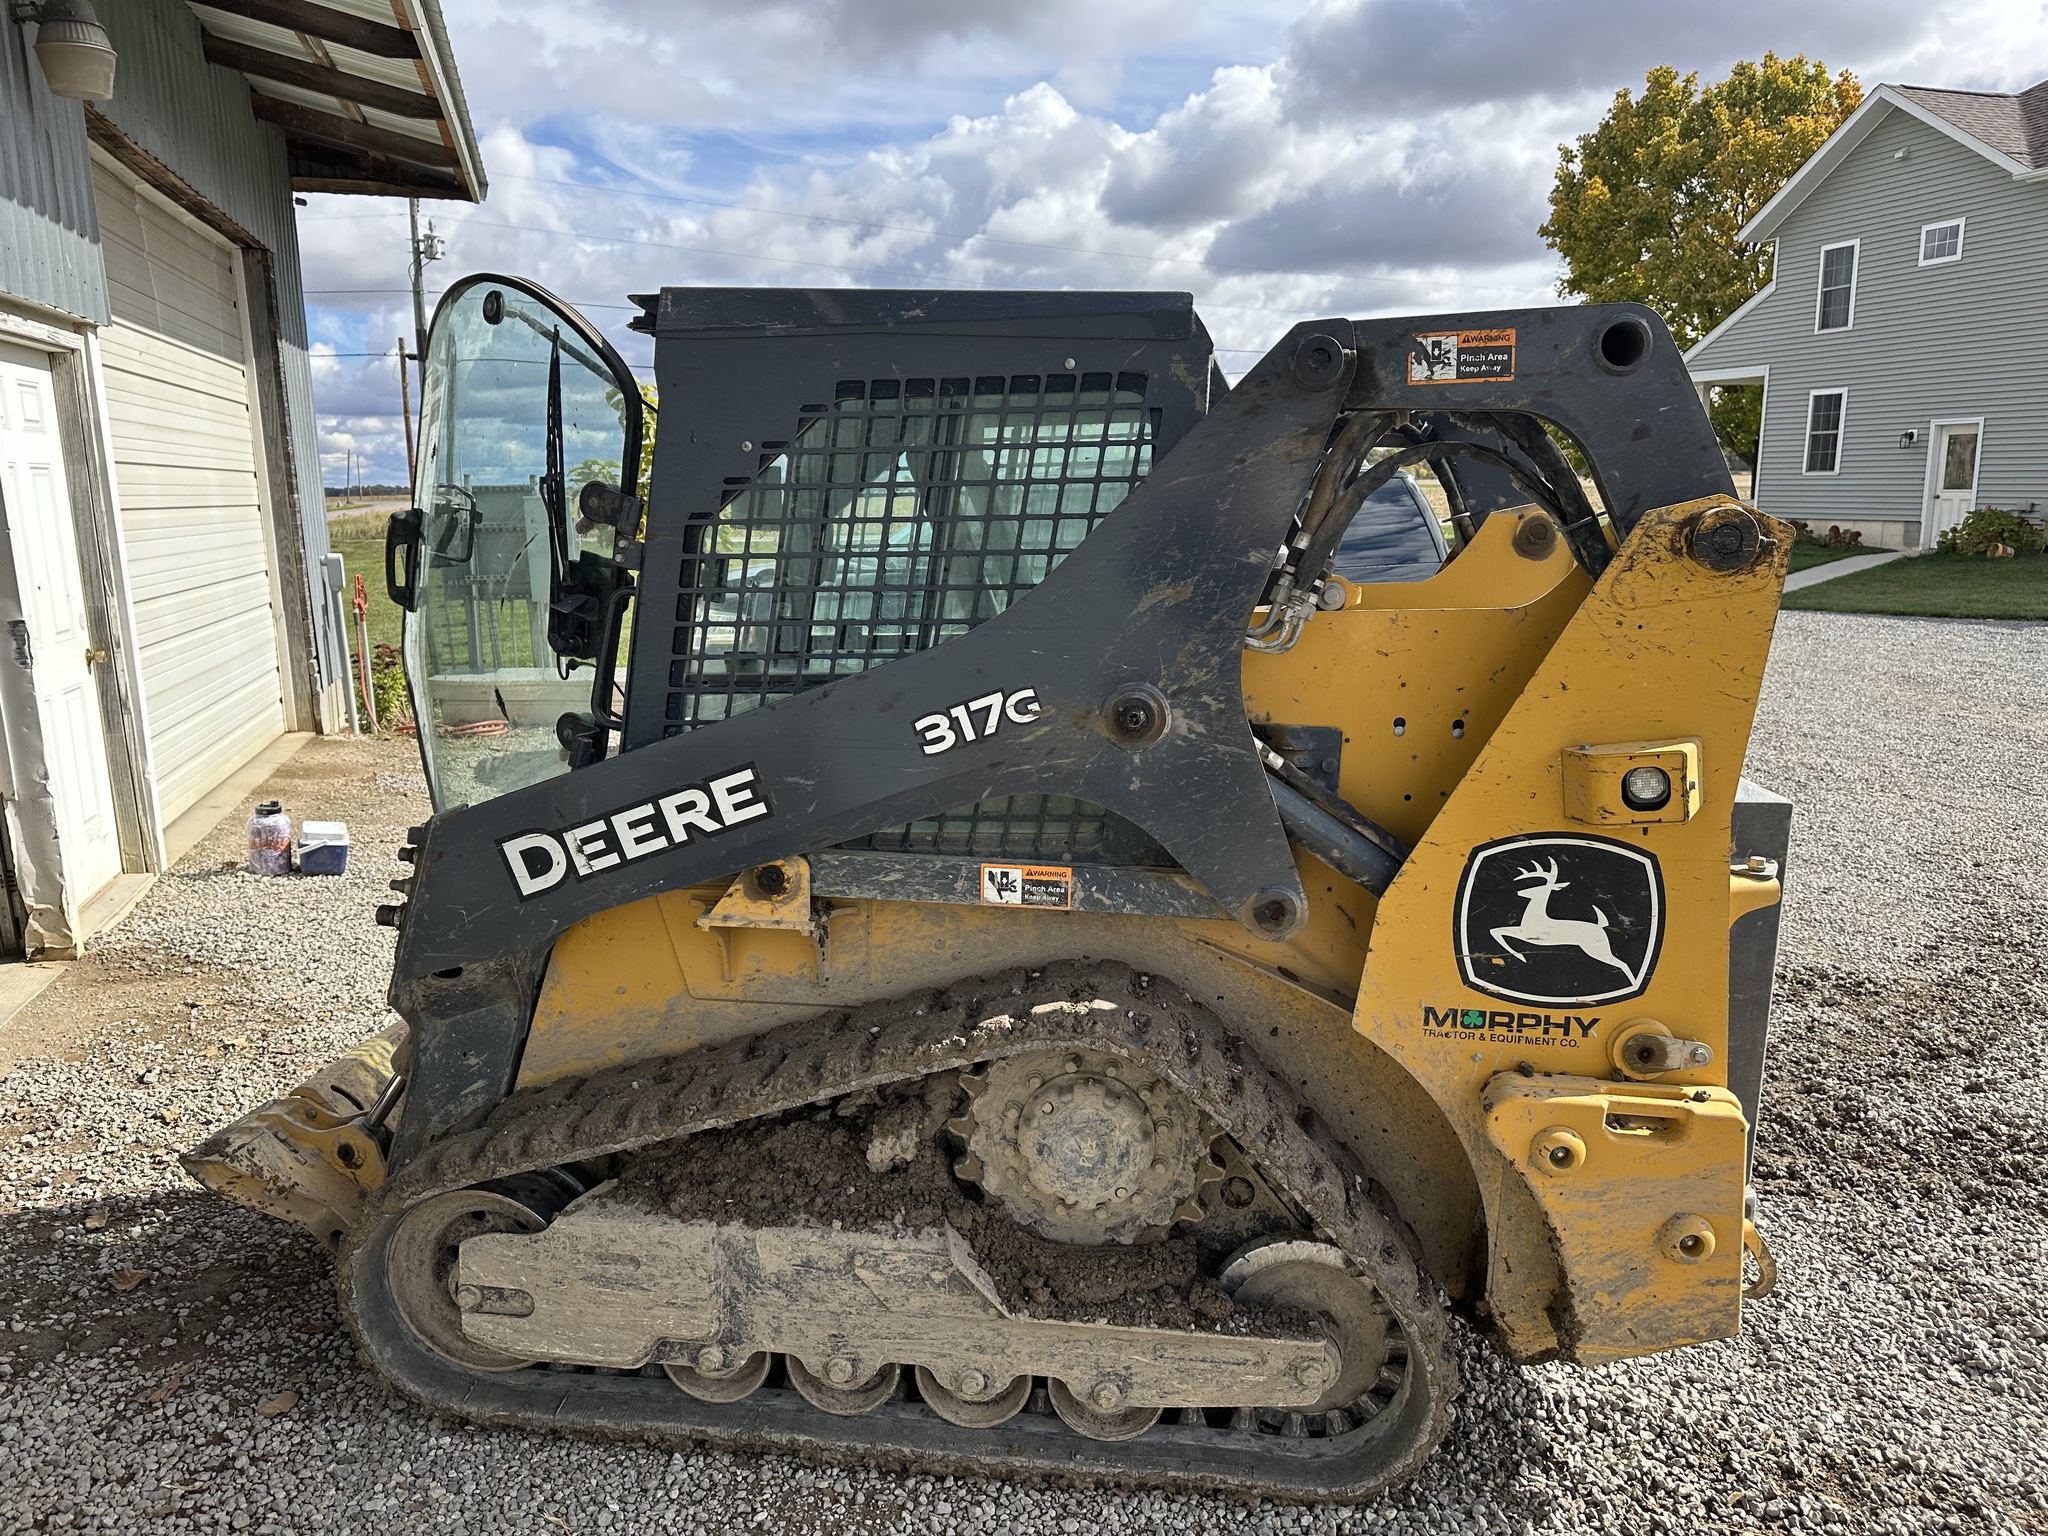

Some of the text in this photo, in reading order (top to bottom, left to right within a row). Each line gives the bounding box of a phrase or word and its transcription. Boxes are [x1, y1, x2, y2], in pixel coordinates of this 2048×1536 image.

[1470, 334, 1511, 343] WARNING
[1460, 353, 1508, 362] Pinch Area
[1460, 365, 1480, 373] Keep
[914, 688, 1042, 755] 317G
[502, 768, 768, 897] DEERE
[1032, 870, 1067, 878] WARNING
[1024, 884, 1065, 893] Pinch Area
[1024, 893, 1041, 901] Keep
[1422, 1028, 1580, 1048] TRACTOR & EQUIPMENT CO.
